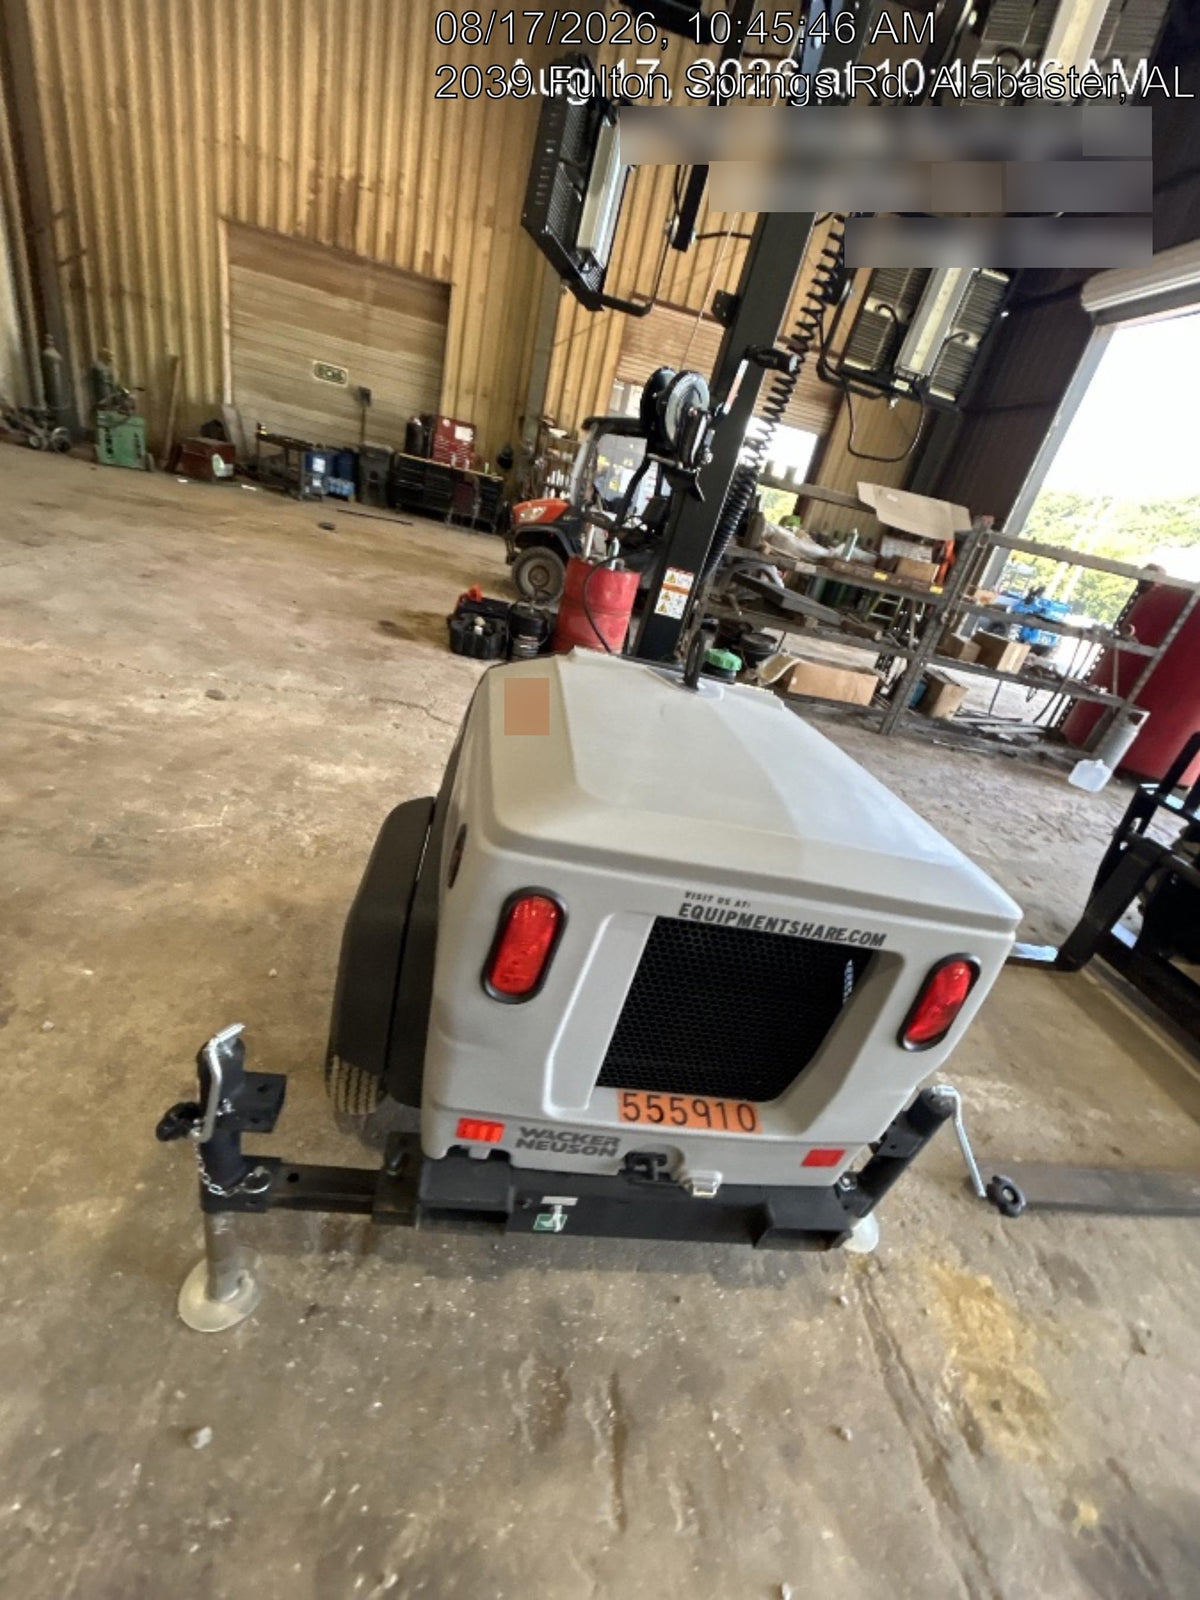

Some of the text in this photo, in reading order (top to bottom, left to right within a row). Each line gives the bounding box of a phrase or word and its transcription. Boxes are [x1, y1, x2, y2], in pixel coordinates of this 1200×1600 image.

[685, 891, 715, 902] VISIT
[678, 903, 887, 947] EQUIPMENTSHARE.COM
[622, 1093, 757, 1132] 555910
[519, 1126, 621, 1146] WACKER
[515, 1139, 619, 1156] NEUSON
